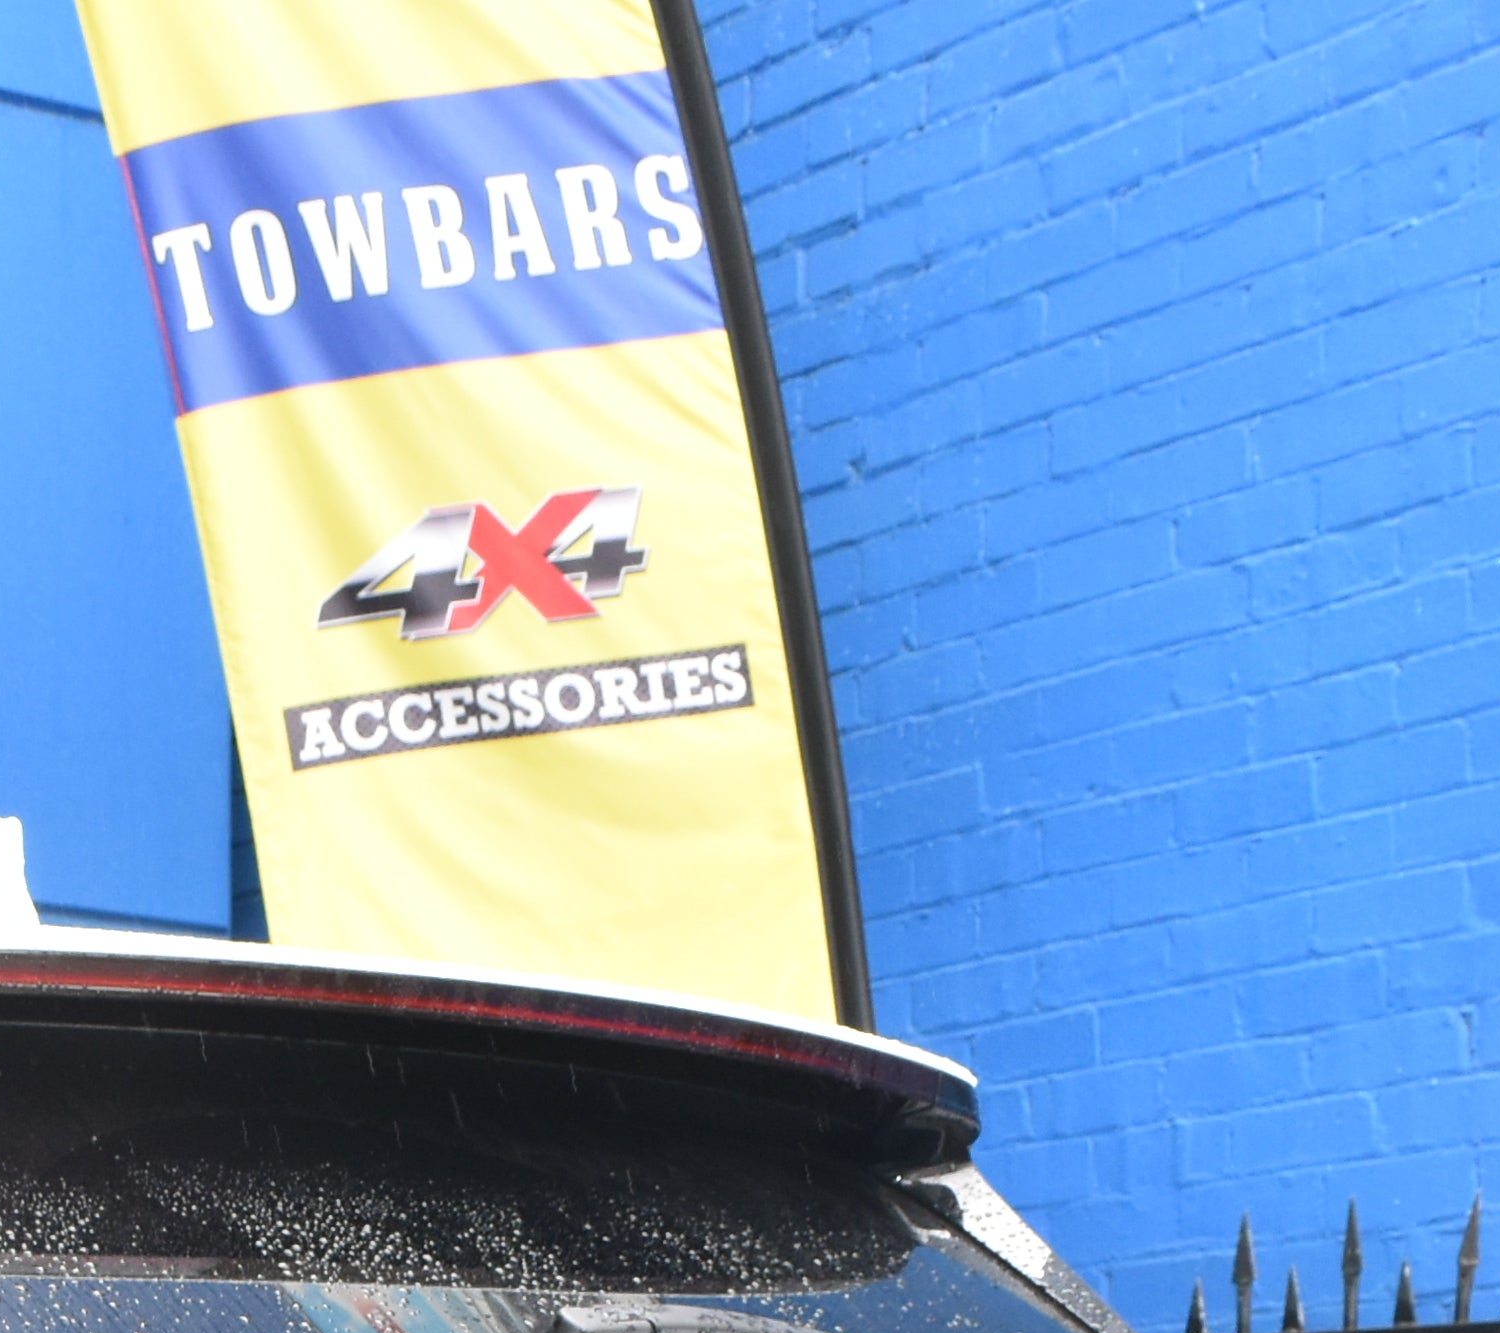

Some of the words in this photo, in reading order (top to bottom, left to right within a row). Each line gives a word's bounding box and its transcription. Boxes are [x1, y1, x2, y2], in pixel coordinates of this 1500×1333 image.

[152, 154, 704, 331] TOWBARS
[316, 485, 650, 641] 4X4
[299, 653, 746, 763] ACCESSORIES
